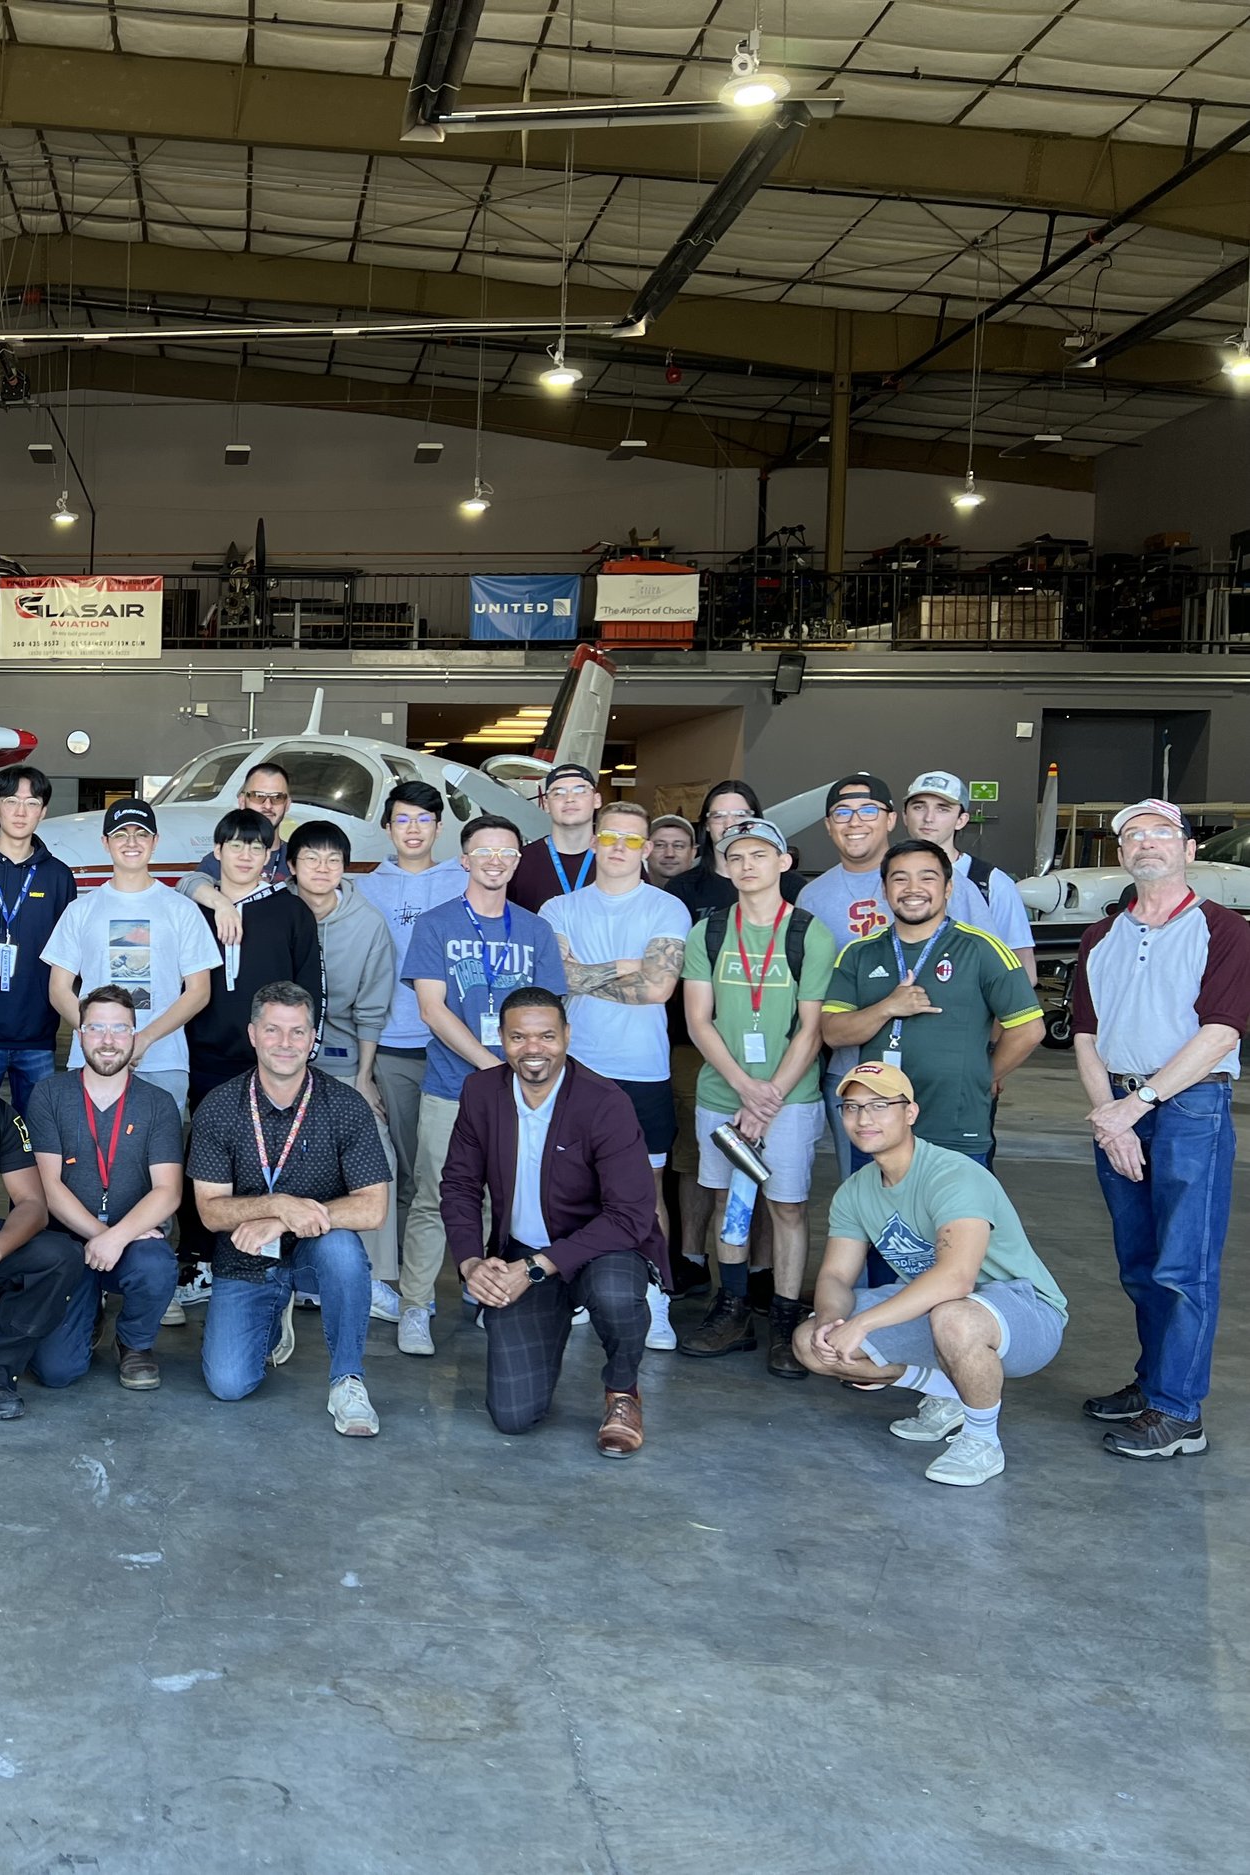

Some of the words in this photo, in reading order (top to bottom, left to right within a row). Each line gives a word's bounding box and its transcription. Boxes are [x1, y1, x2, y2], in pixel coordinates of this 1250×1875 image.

[15, 592, 145, 619] GLASAIR
[474, 603, 549, 614] UNITED
[620, 606, 650, 616] Airport
[652, 606, 662, 615] of
[50, 620, 109, 628] AVIATION
